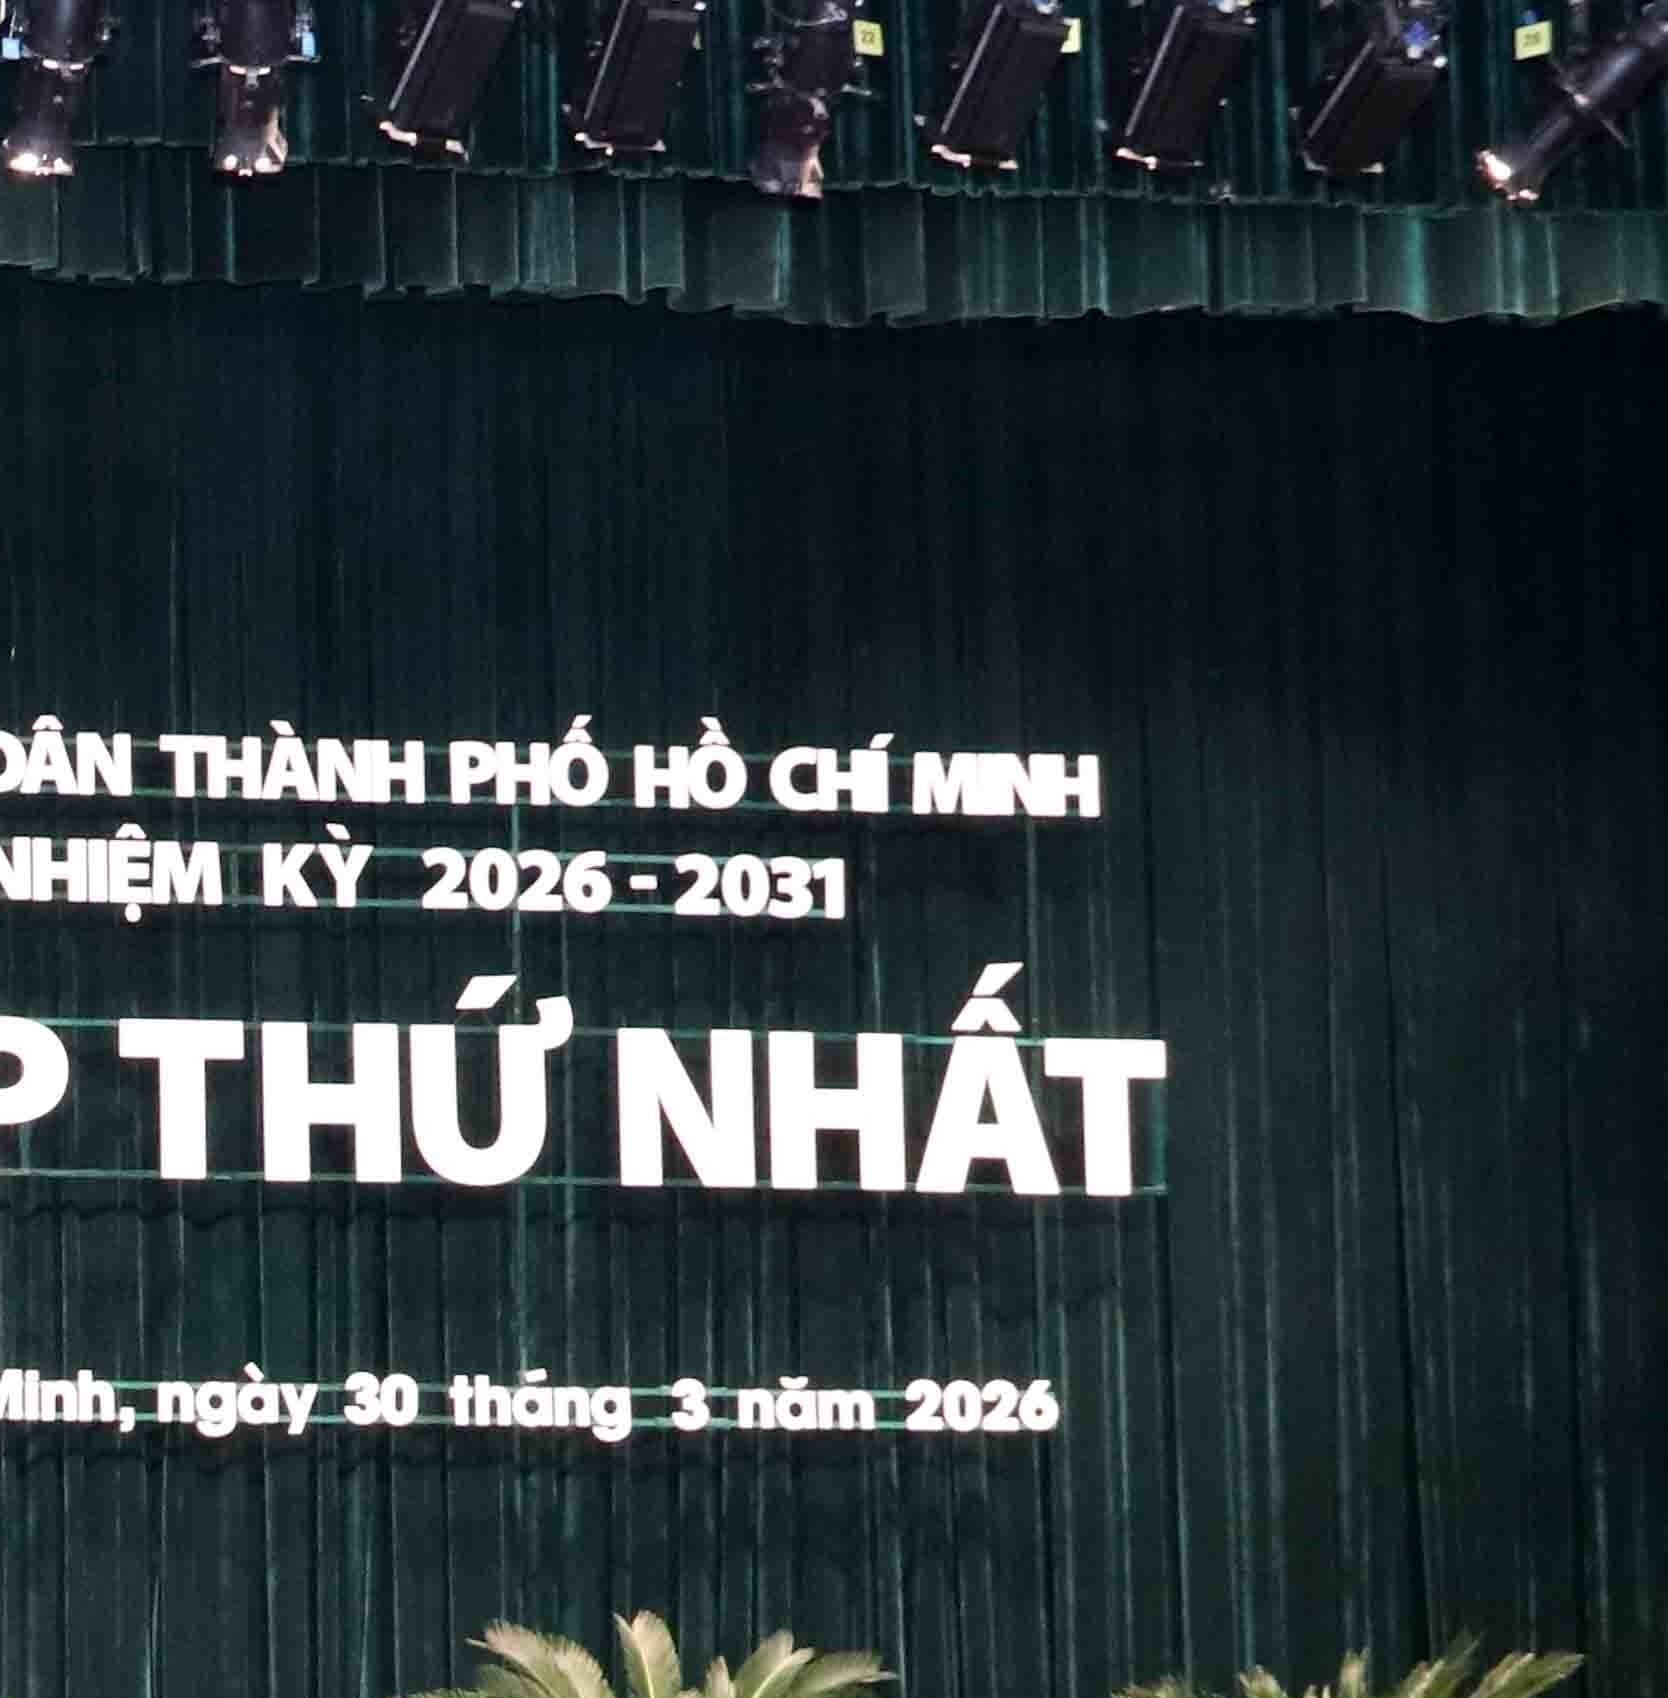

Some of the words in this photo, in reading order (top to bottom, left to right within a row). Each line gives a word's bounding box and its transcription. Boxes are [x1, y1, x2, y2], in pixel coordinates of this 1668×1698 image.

[159, 720, 425, 803] THÀNH
[449, 715, 609, 806] PHỐ
[634, 717, 747, 808] HỒ
[770, 734, 893, 812] CHÍ
[912, 752, 1100, 817] MINH
[262, 824, 373, 907] KỲ
[118, 975, 573, 1186] THỨ
[617, 962, 1166, 1196] NHẤT
[157, 1362, 317, 1436] ngày
[344, 1372, 419, 1426] 30
[449, 1368, 631, 1442] tháng
[671, 1378, 711, 1431] 3
[737, 1376, 876, 1431] năm
[904, 1379, 1059, 1432] 2026
